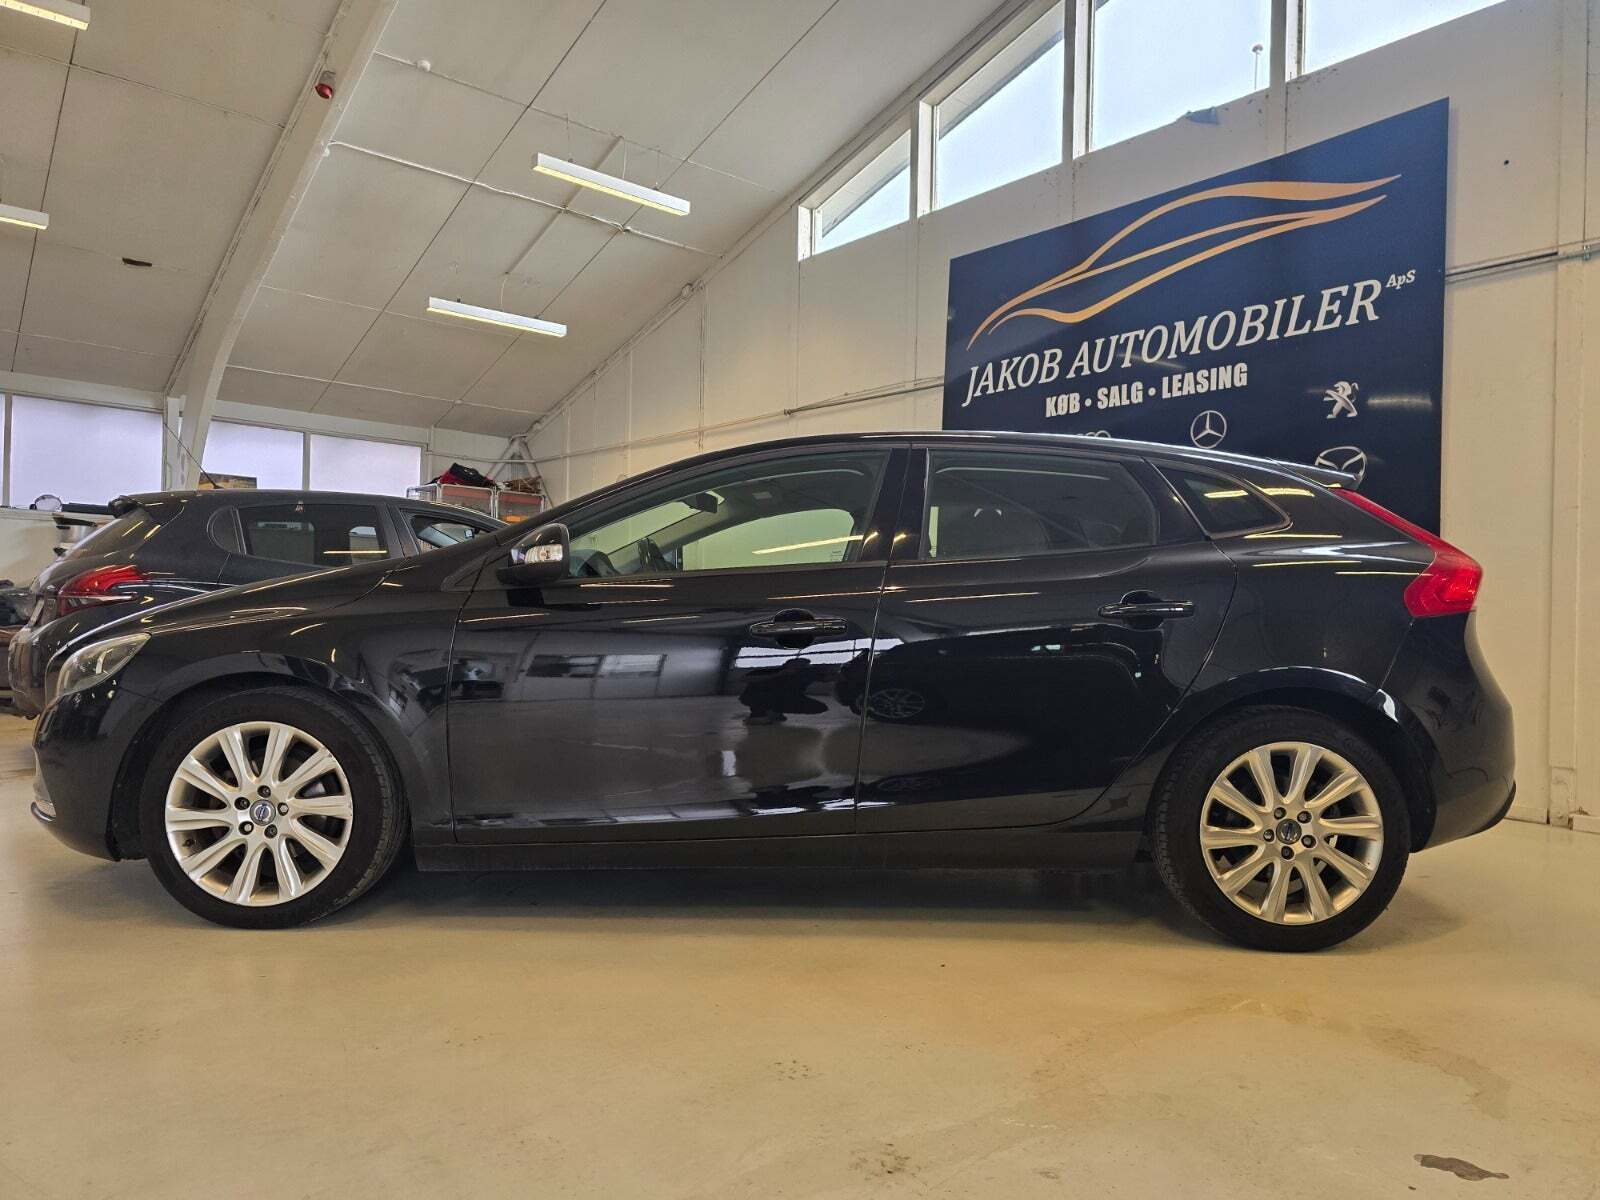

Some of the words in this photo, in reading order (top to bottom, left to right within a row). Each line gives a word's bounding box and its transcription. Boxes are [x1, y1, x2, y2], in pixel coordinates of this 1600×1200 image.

[961, 348, 1063, 407] JAKOB
[1066, 279, 1382, 379] AUTOMOBILER
[1385, 269, 1417, 290] ApS
[1045, 392, 1081, 418] KØB
[1097, 381, 1144, 410] SALG
[1161, 362, 1248, 400] LEASING
